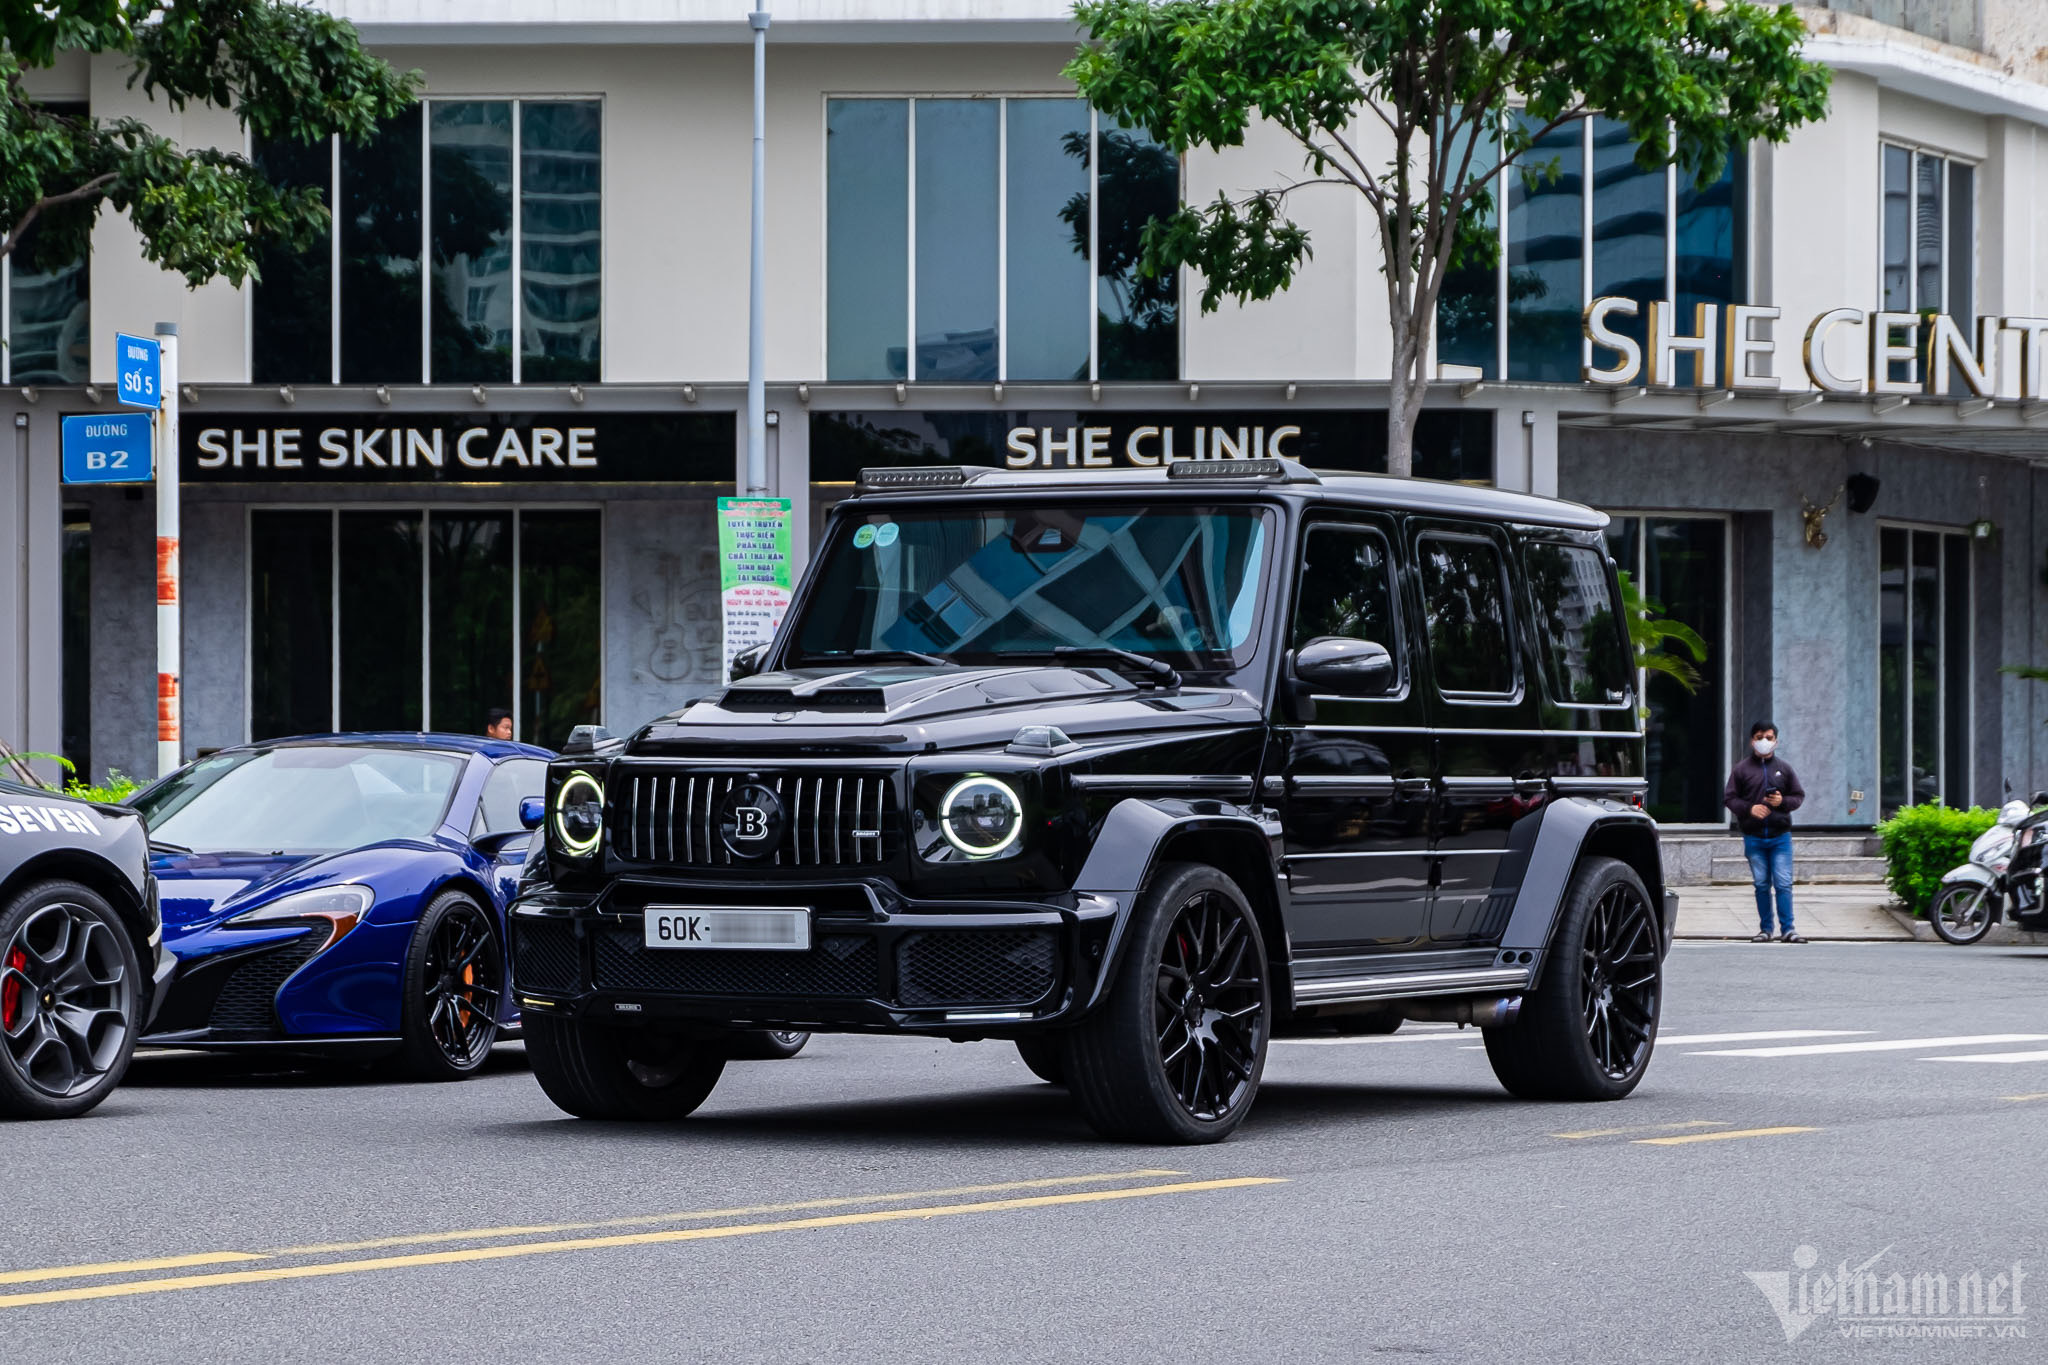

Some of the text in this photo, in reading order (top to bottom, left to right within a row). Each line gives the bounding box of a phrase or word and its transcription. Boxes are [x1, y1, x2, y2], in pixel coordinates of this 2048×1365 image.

[1582, 296, 1781, 389] SHE
[124, 367, 153, 395] SỐ 5
[87, 450, 129, 469] B2
[197, 427, 598, 468] SHE SKIN CARE
[1006, 425, 1301, 466] SHE CLINIC
[0, 805, 101, 836] SEVEN
[736, 806, 768, 840] B
